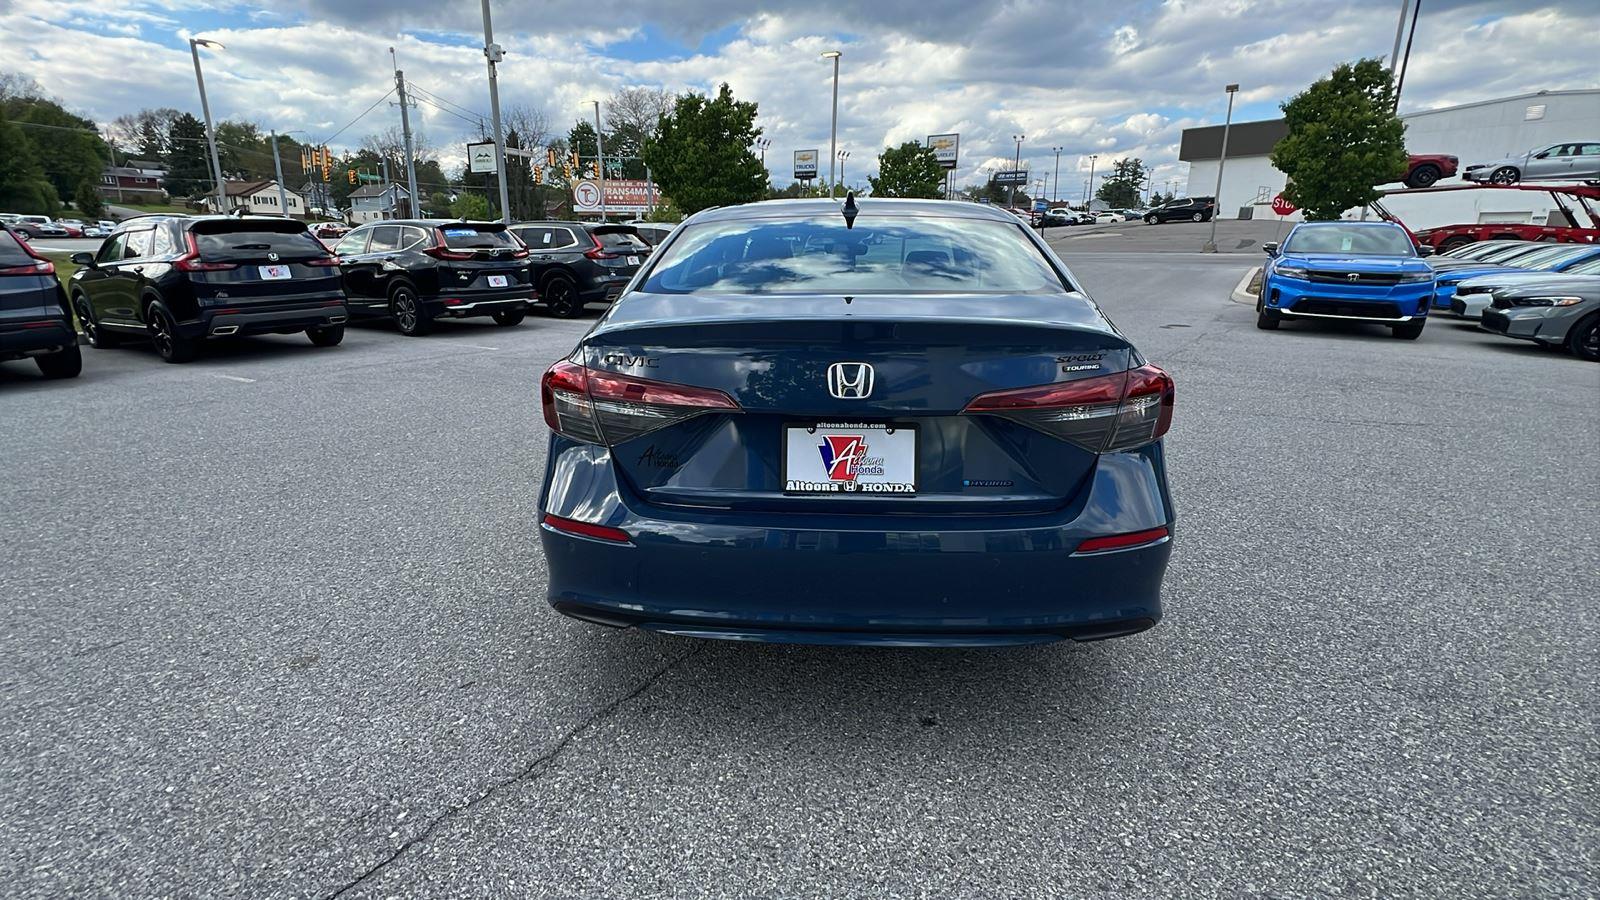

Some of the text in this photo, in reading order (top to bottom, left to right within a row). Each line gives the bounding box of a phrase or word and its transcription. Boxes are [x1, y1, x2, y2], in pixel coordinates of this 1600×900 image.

[604, 354, 660, 369] CIVIC
[1056, 353, 1107, 364] SPORT
[850, 465, 884, 475] Honda
[786, 480, 839, 491] Altoona
[861, 482, 916, 493] HONDA
